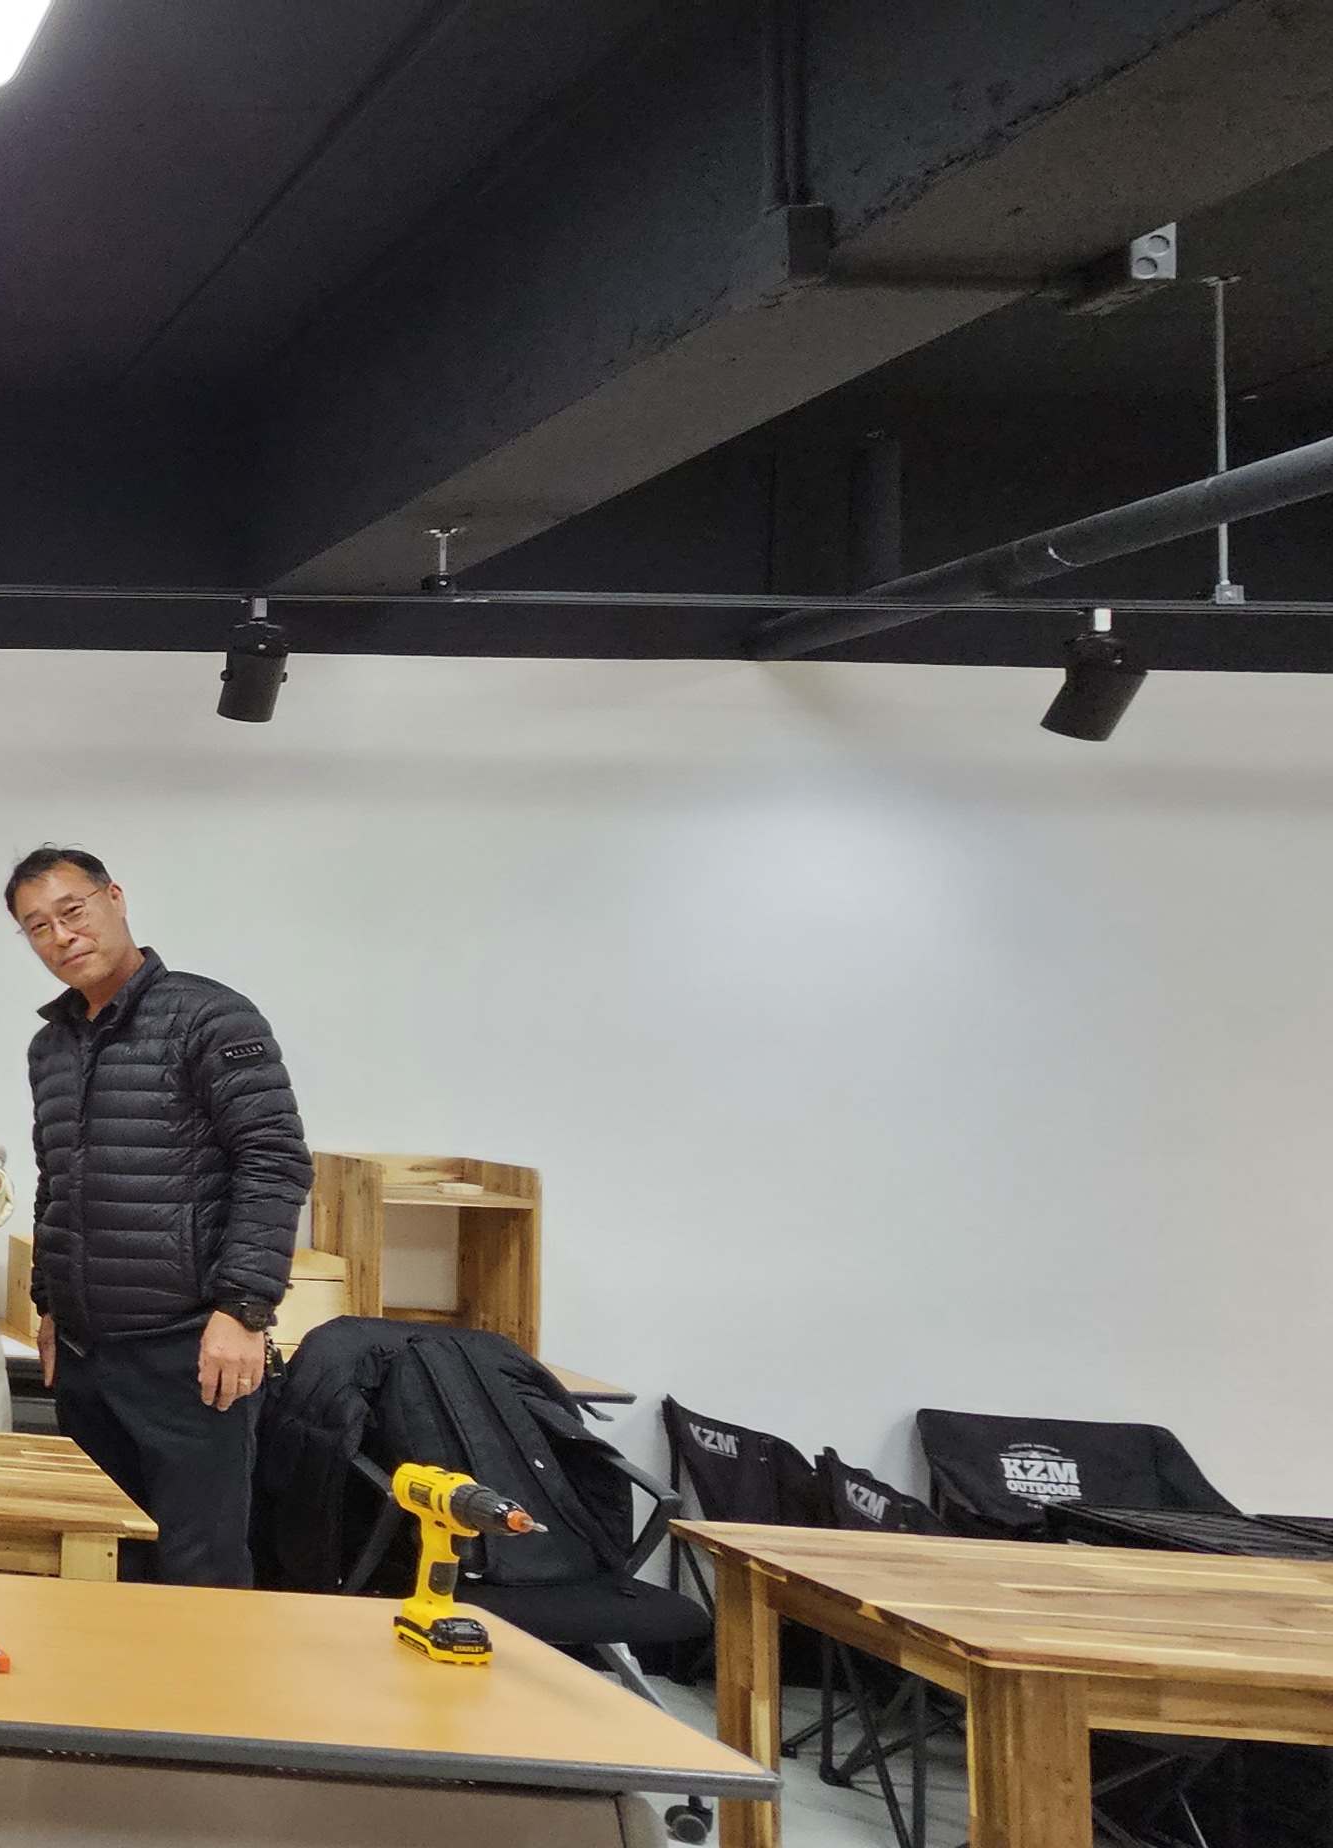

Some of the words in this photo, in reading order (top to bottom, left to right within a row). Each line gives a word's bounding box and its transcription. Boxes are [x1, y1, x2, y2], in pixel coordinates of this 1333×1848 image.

[689, 1422, 738, 1455] KZM
[1000, 1458, 1081, 1484] KZM
[845, 1479, 889, 1519] KZM
[1006, 1480, 1082, 1497] OUTDOOR
